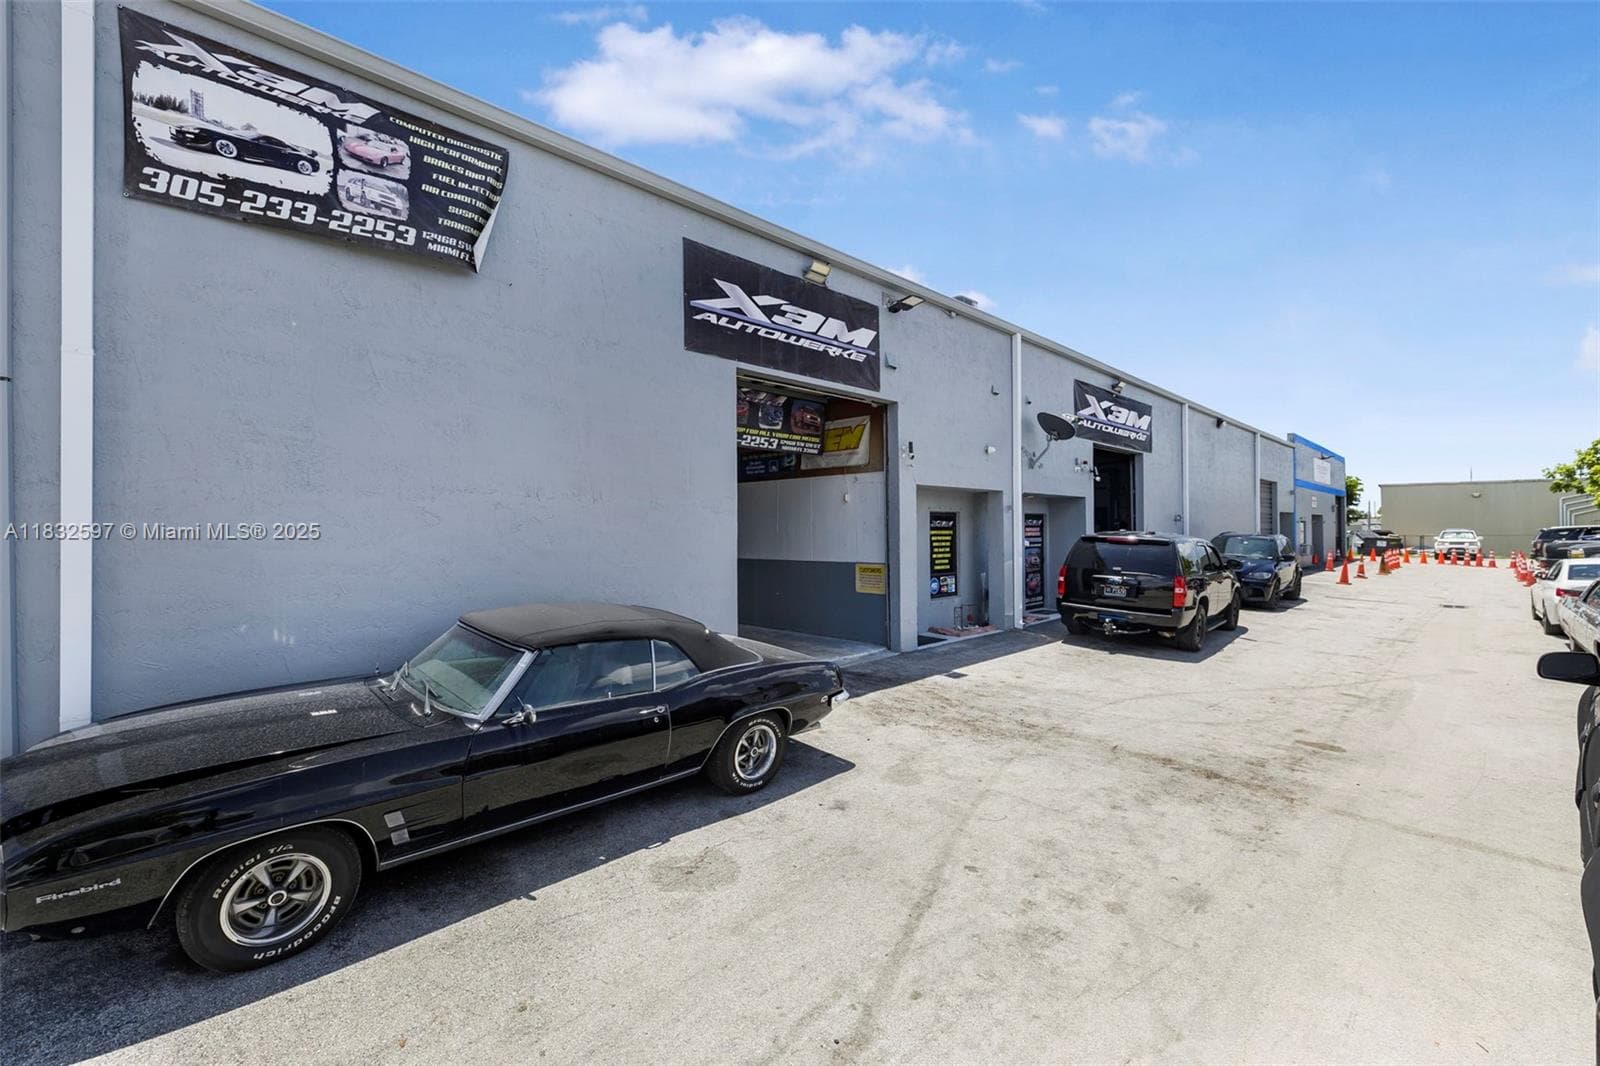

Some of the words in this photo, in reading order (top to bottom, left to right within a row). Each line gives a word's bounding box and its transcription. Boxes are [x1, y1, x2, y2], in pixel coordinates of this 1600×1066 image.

[389, 116, 445, 142] COMPUTER
[446, 137, 504, 161] DIAGNOSTIC
[409, 135, 435, 150] HIGH
[436, 144, 503, 175] PERFORMANCE
[423, 155, 464, 176] BRAKES
[465, 168, 485, 182] AND
[486, 175, 503, 189] ABS
[432, 173, 456, 187] FUEL
[139, 166, 417, 246] 305-233-2253
[421, 183, 440, 196] AIR
[422, 230, 457, 246] 12468
[427, 242, 460, 258] MIAMI
[692, 312, 867, 362] AUTOWERKE
[1078, 419, 1147, 441] AUTOWERKE
[212, 853, 261, 899] Radial
[268, 844, 294, 854] T/A
[36, 878, 121, 904] Firebird
[253, 895, 342, 960] BFGoodrich
